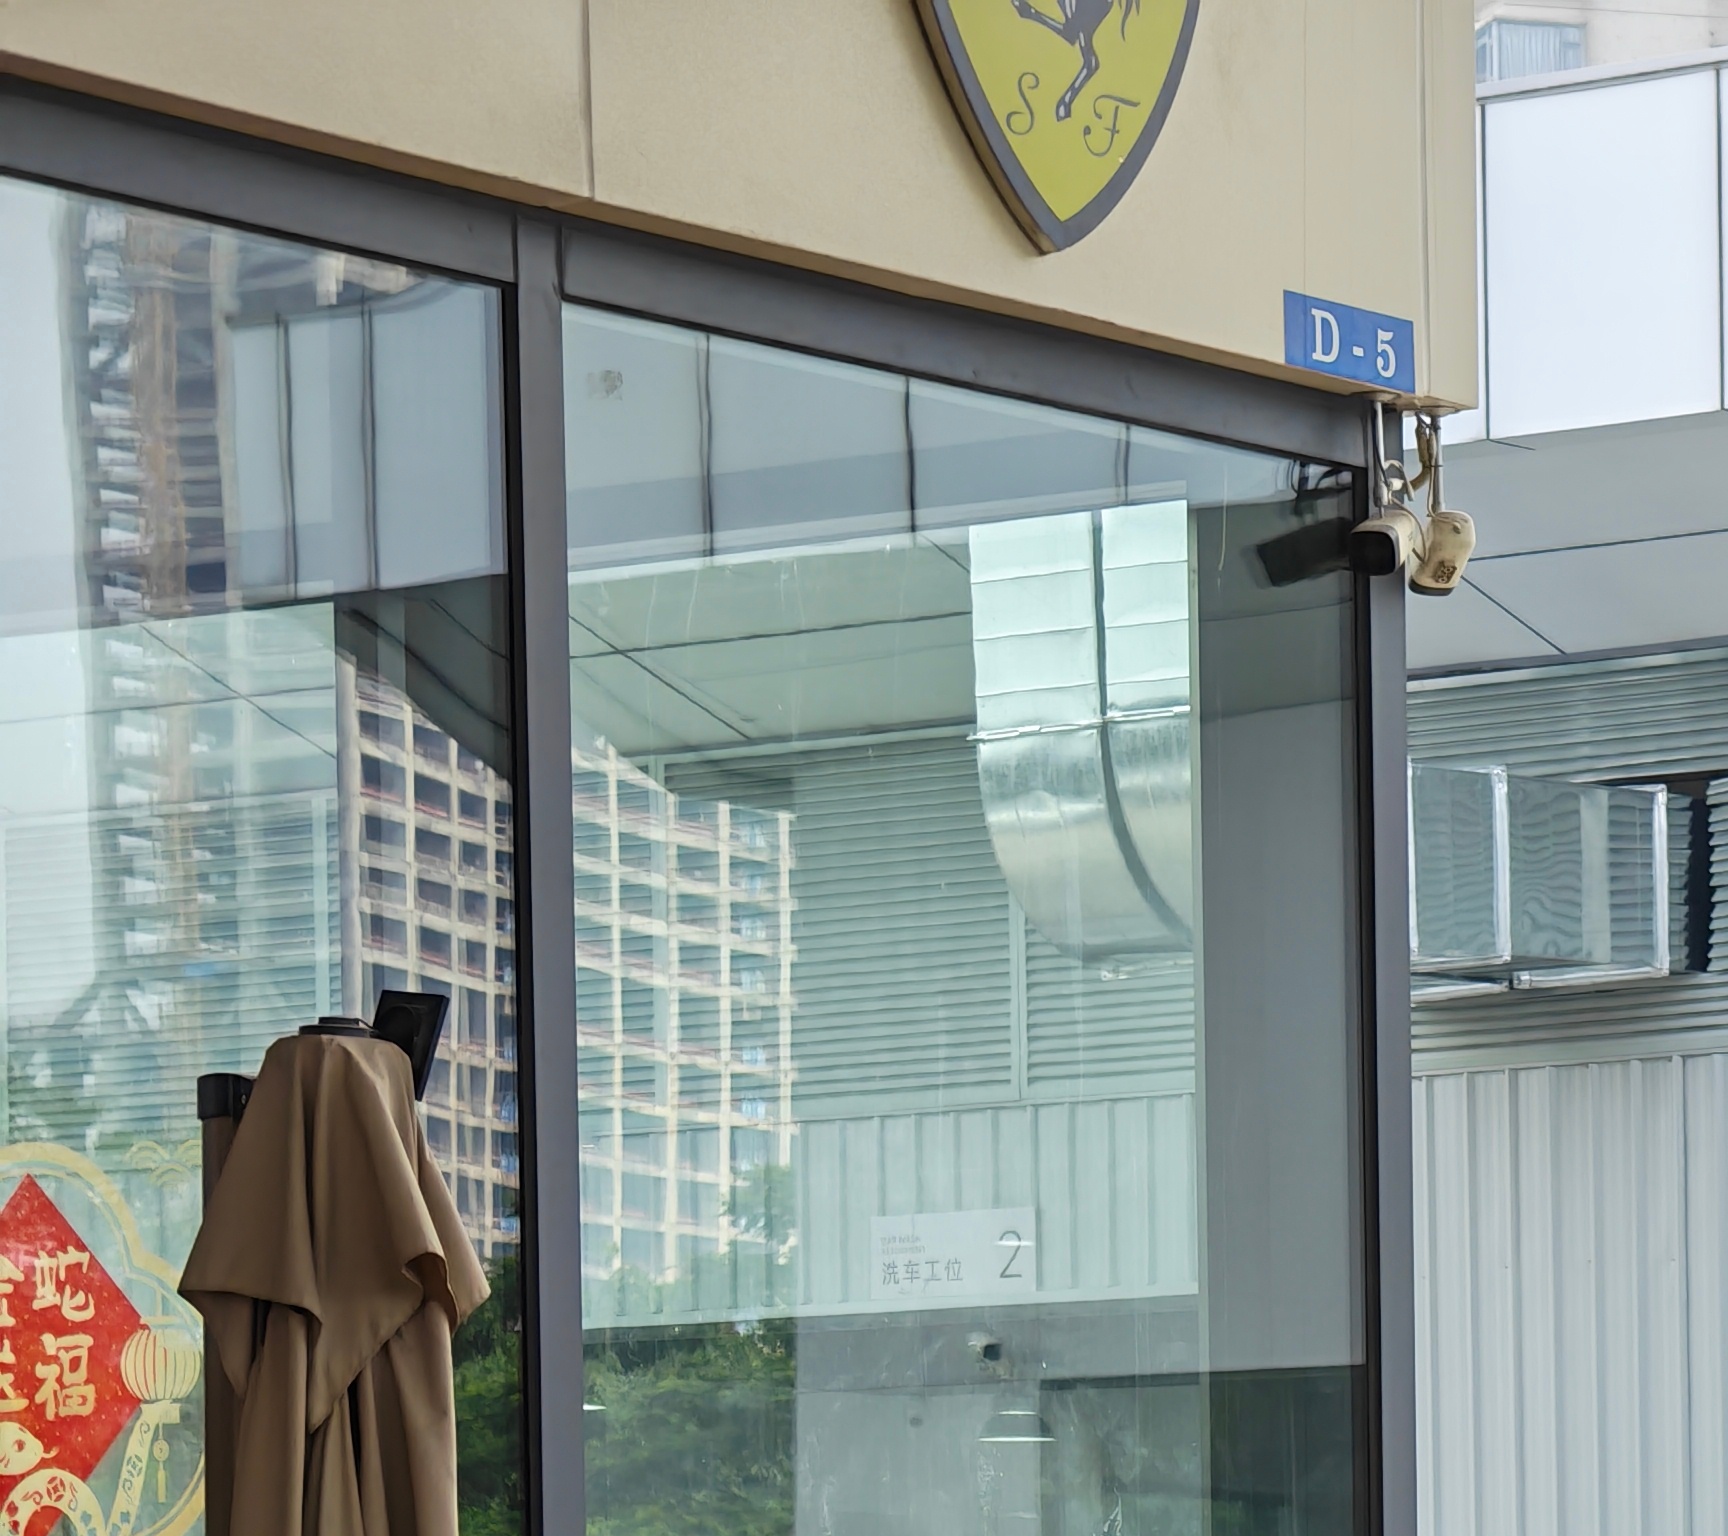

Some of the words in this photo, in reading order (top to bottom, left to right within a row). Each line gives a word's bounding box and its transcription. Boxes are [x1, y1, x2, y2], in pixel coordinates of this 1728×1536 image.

[1006, 72, 1041, 135] S
[1083, 95, 1141, 157] F
[882, 1258, 964, 1285] 洗车工位
[998, 1230, 1023, 1279] 2
